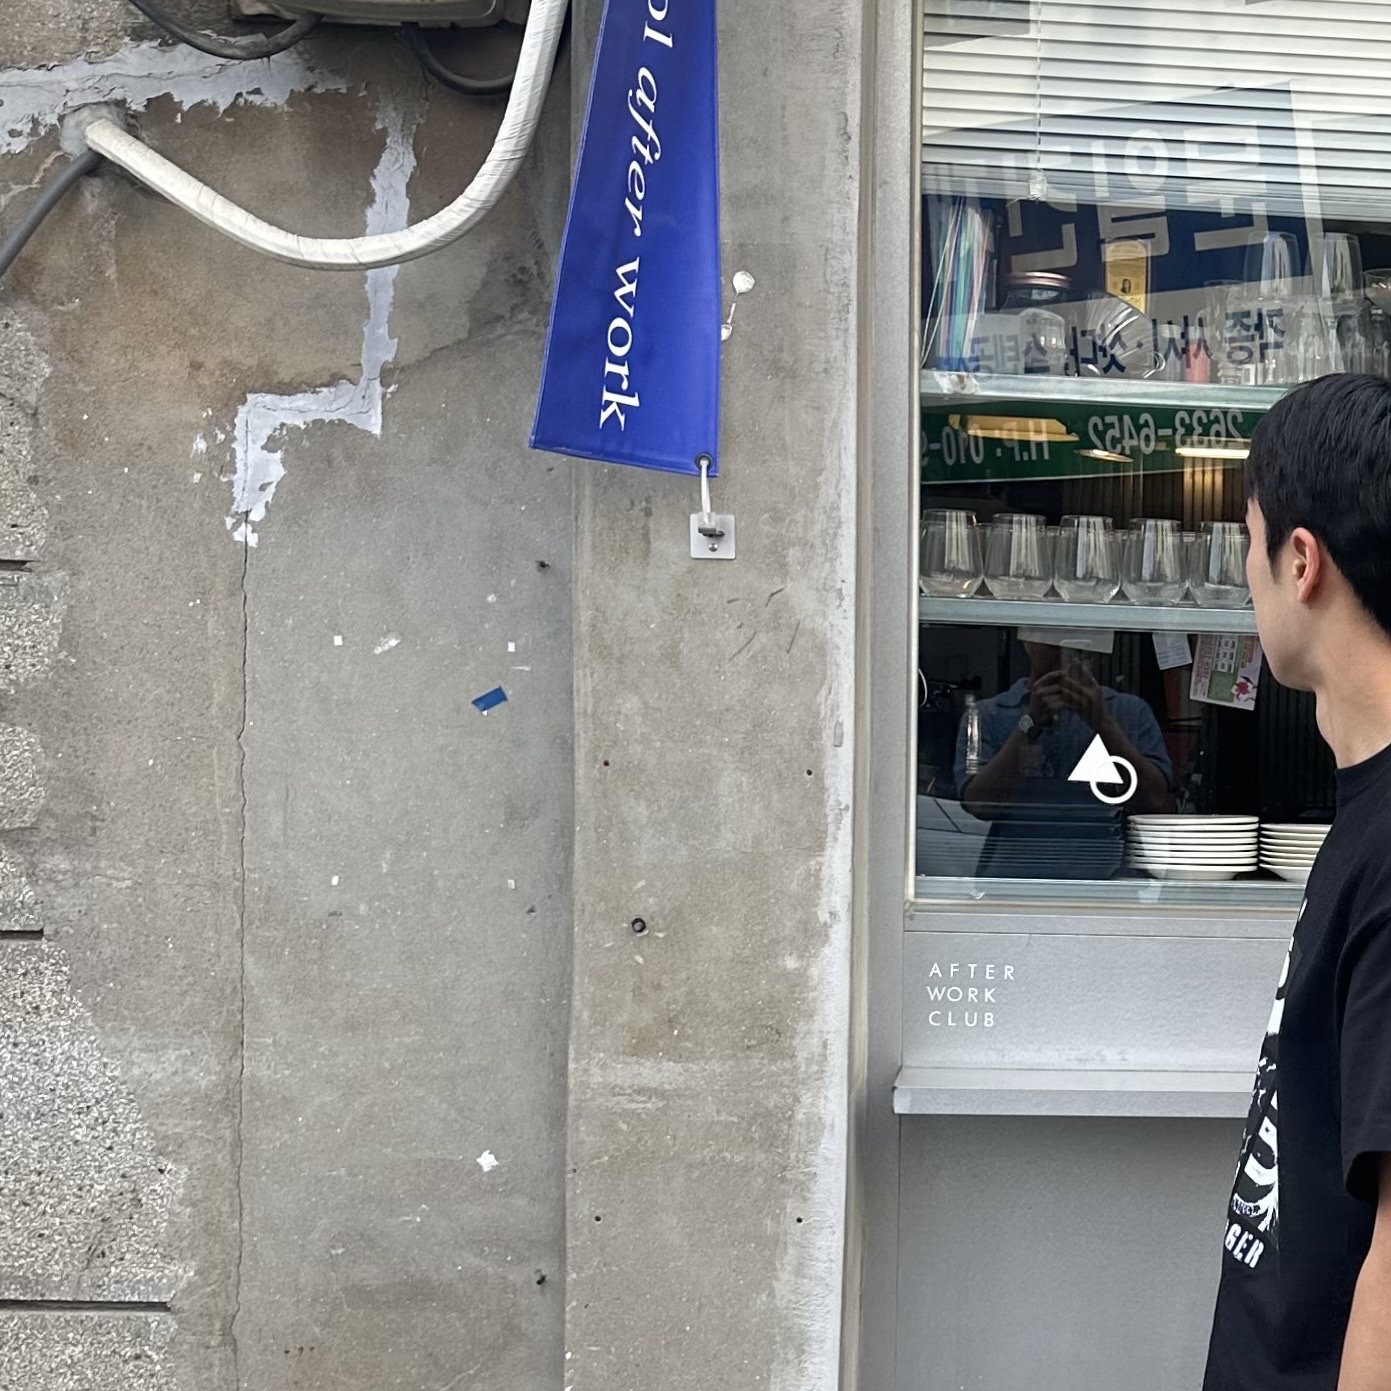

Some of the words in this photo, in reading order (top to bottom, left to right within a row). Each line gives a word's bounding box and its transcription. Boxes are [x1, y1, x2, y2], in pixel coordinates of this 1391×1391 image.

[625, 66, 661, 237] after
[599, 256, 640, 431] work
[928, 962, 1015, 981] AFTER
[926, 986, 996, 1003] WORK
[928, 1010, 994, 1027] CLUB
